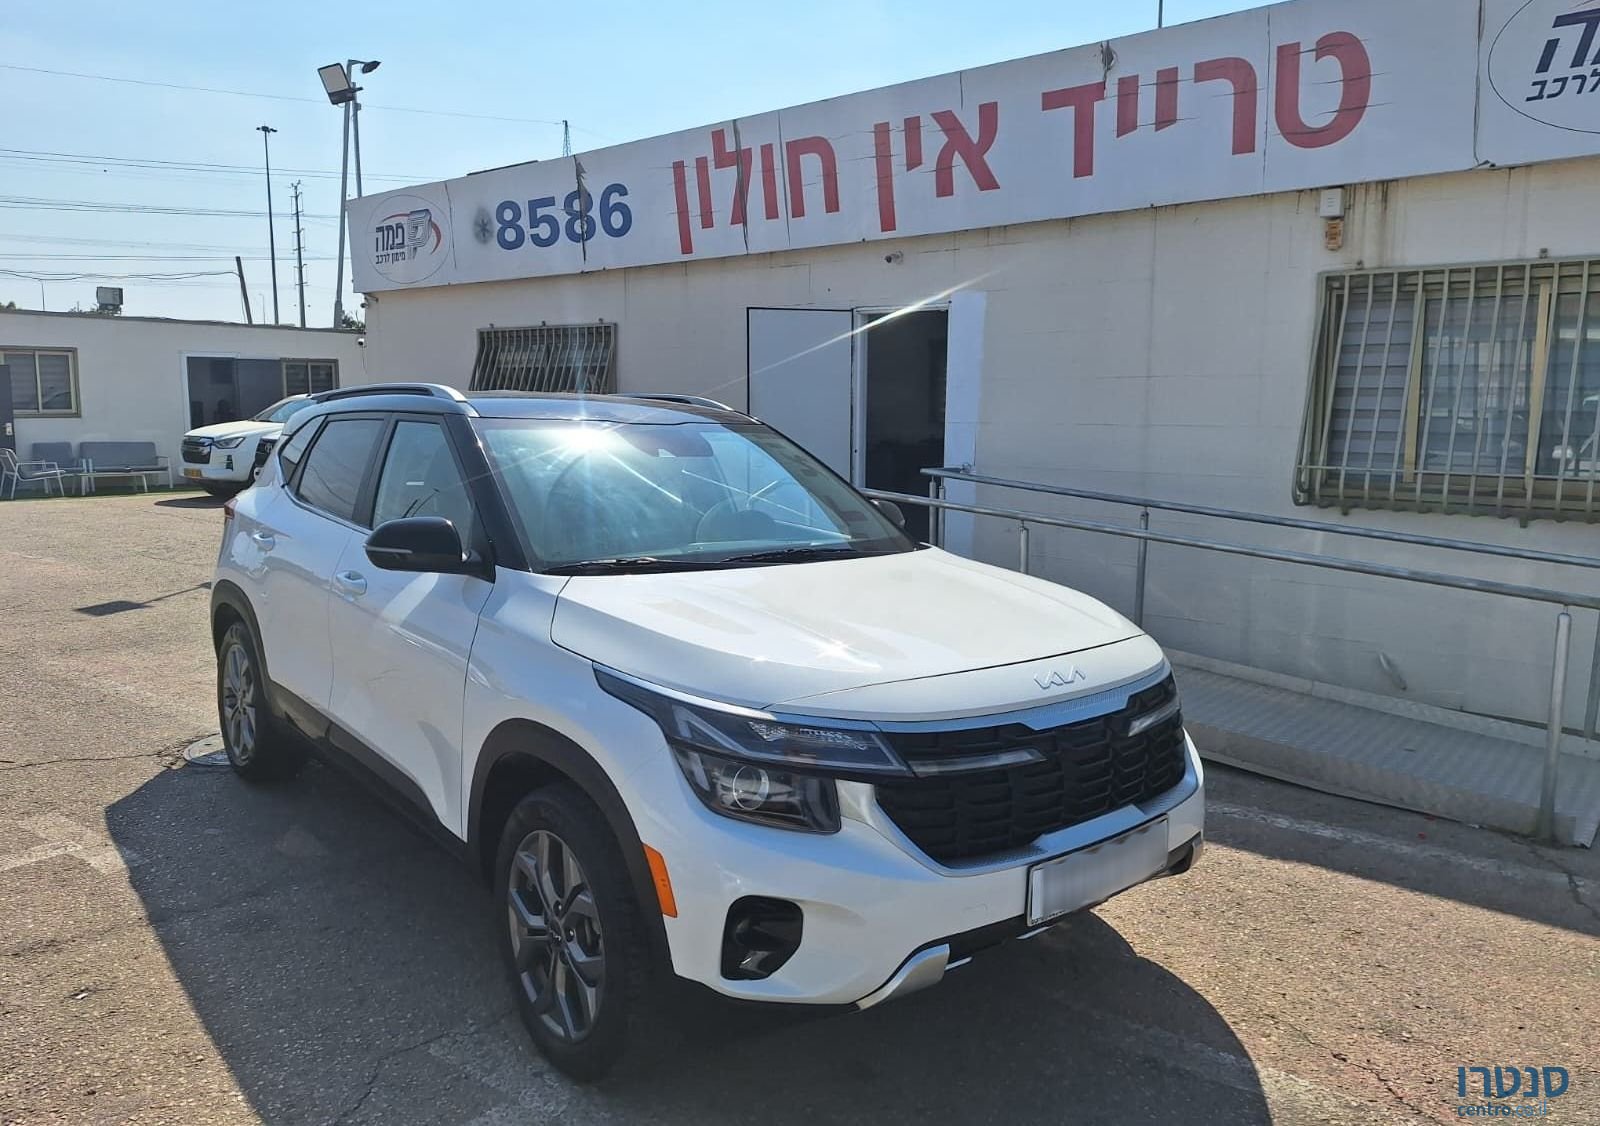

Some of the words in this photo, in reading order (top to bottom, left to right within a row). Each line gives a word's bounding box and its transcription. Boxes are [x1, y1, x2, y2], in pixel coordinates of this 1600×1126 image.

[873, 101, 1001, 232] אין
[1041, 31, 1372, 179] טרייד
[375, 222, 405, 252] פמה
[672, 128, 840, 255] חולון
